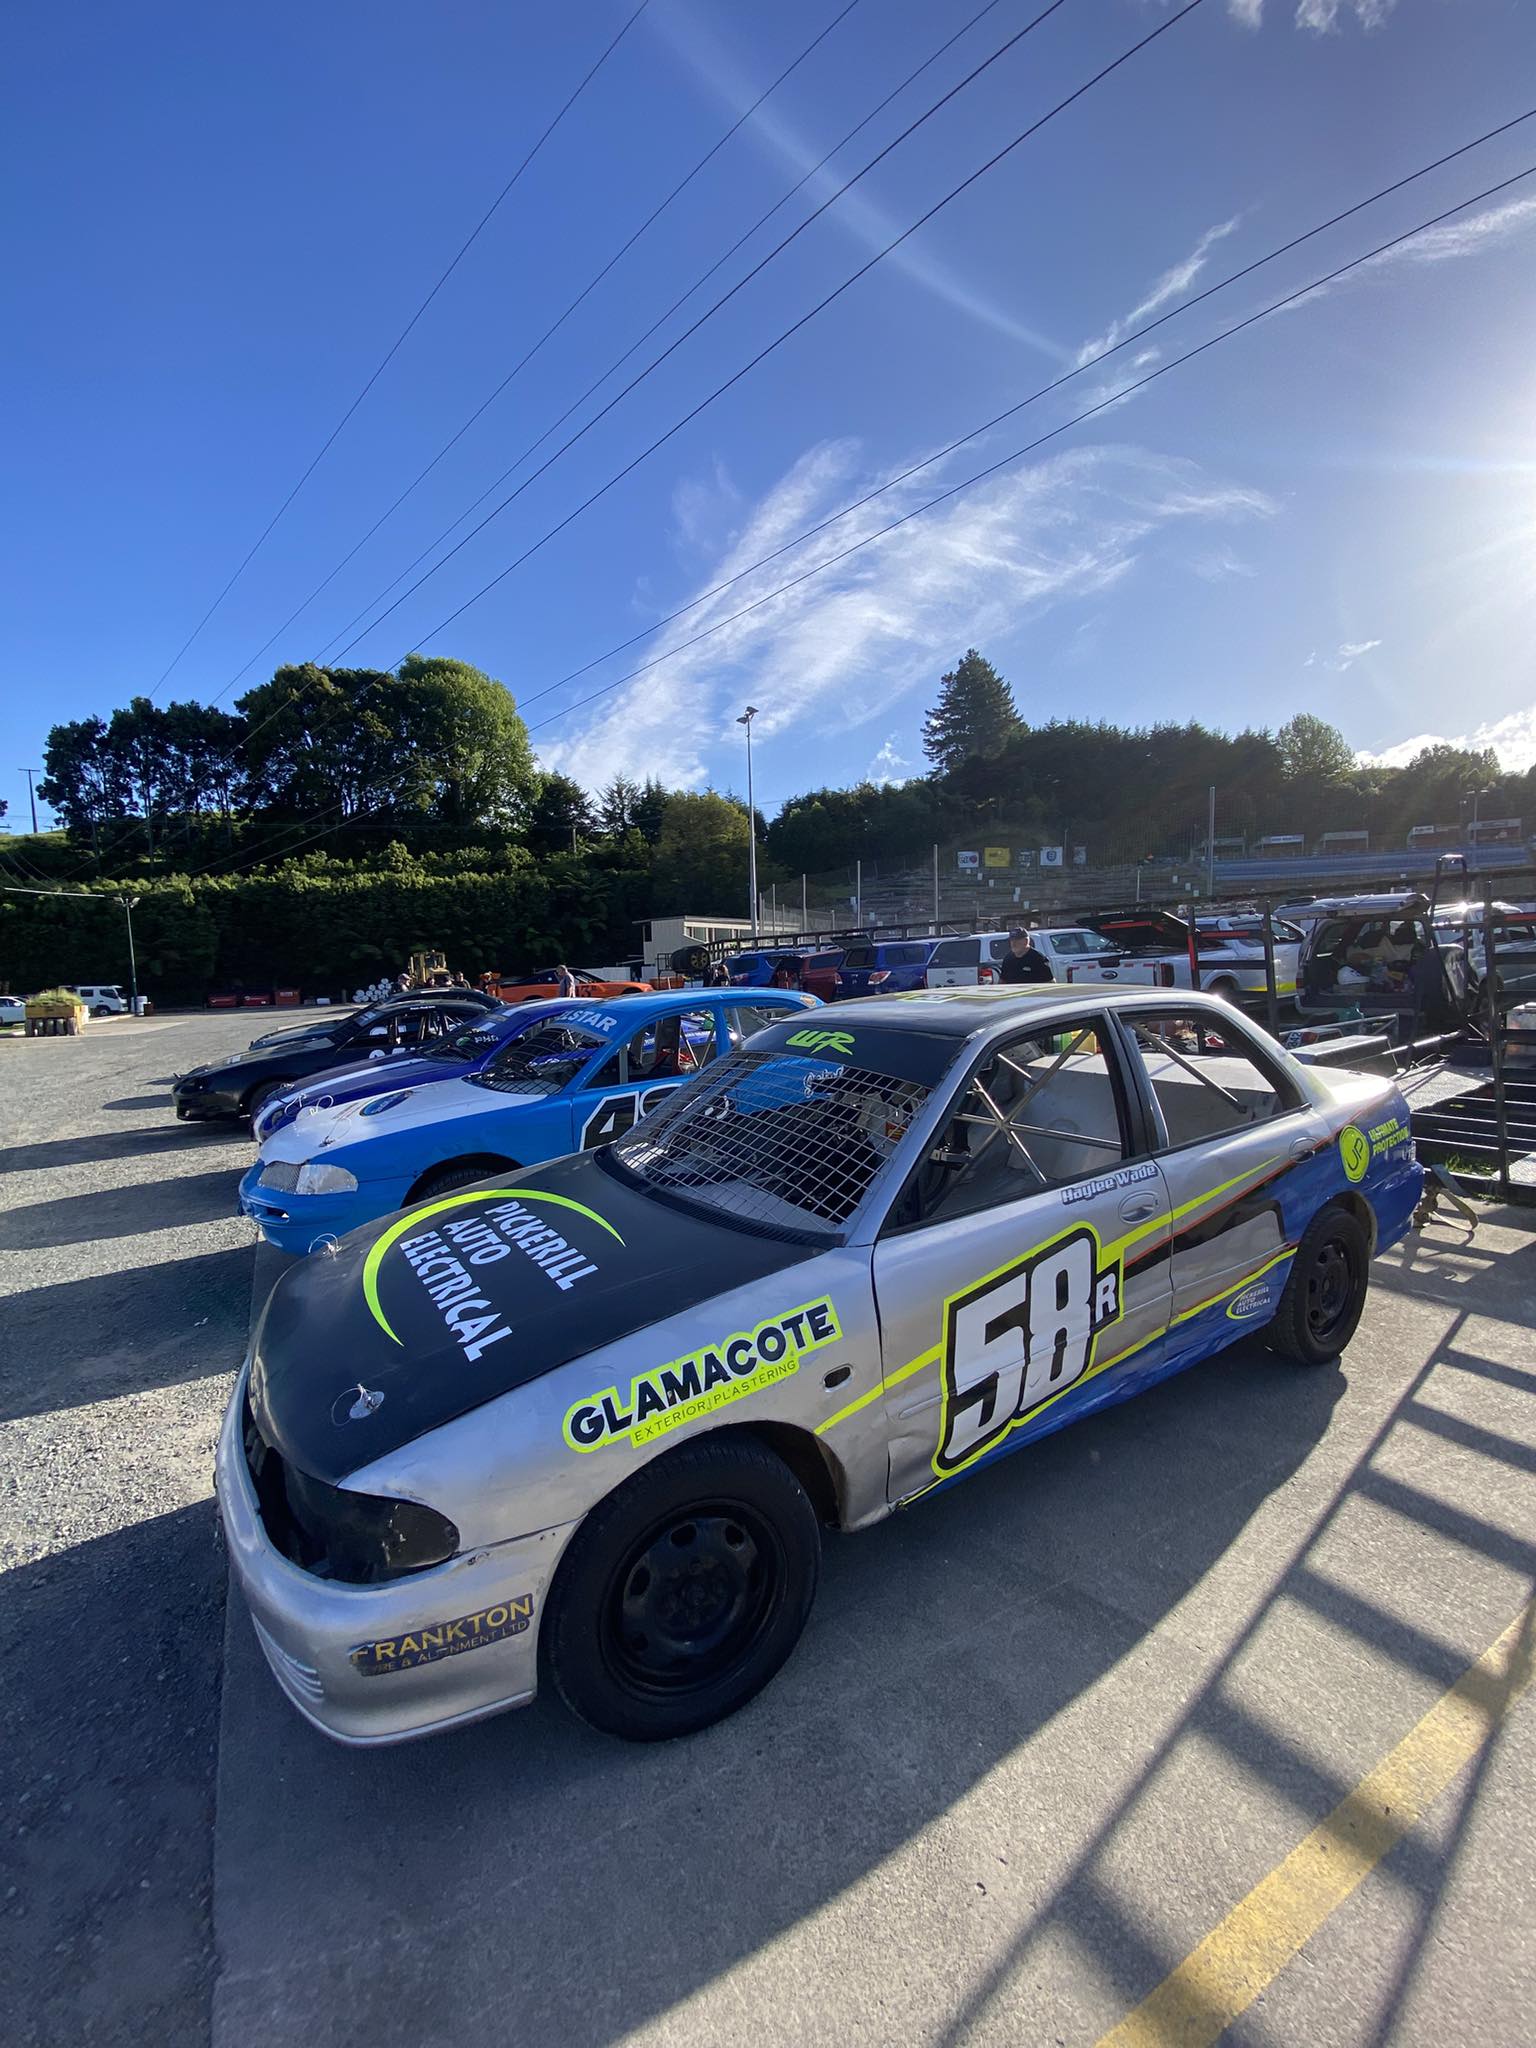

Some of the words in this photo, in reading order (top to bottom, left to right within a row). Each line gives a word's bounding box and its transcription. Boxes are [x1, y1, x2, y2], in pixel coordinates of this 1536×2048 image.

[1061, 1177, 1117, 1205] Haylee
[1115, 1164, 1158, 1188] Wade
[442, 1217, 511, 1265] AUTO
[484, 1200, 599, 1291] PICKERILL
[400, 1230, 513, 1362] ELECTRICAL
[570, 1303, 836, 1445] GLAMACOTE
[634, 1402, 706, 1442] EXTERIOR
[713, 1360, 797, 1405] PLASTERING
[351, 1597, 530, 1665] FRANKTON
